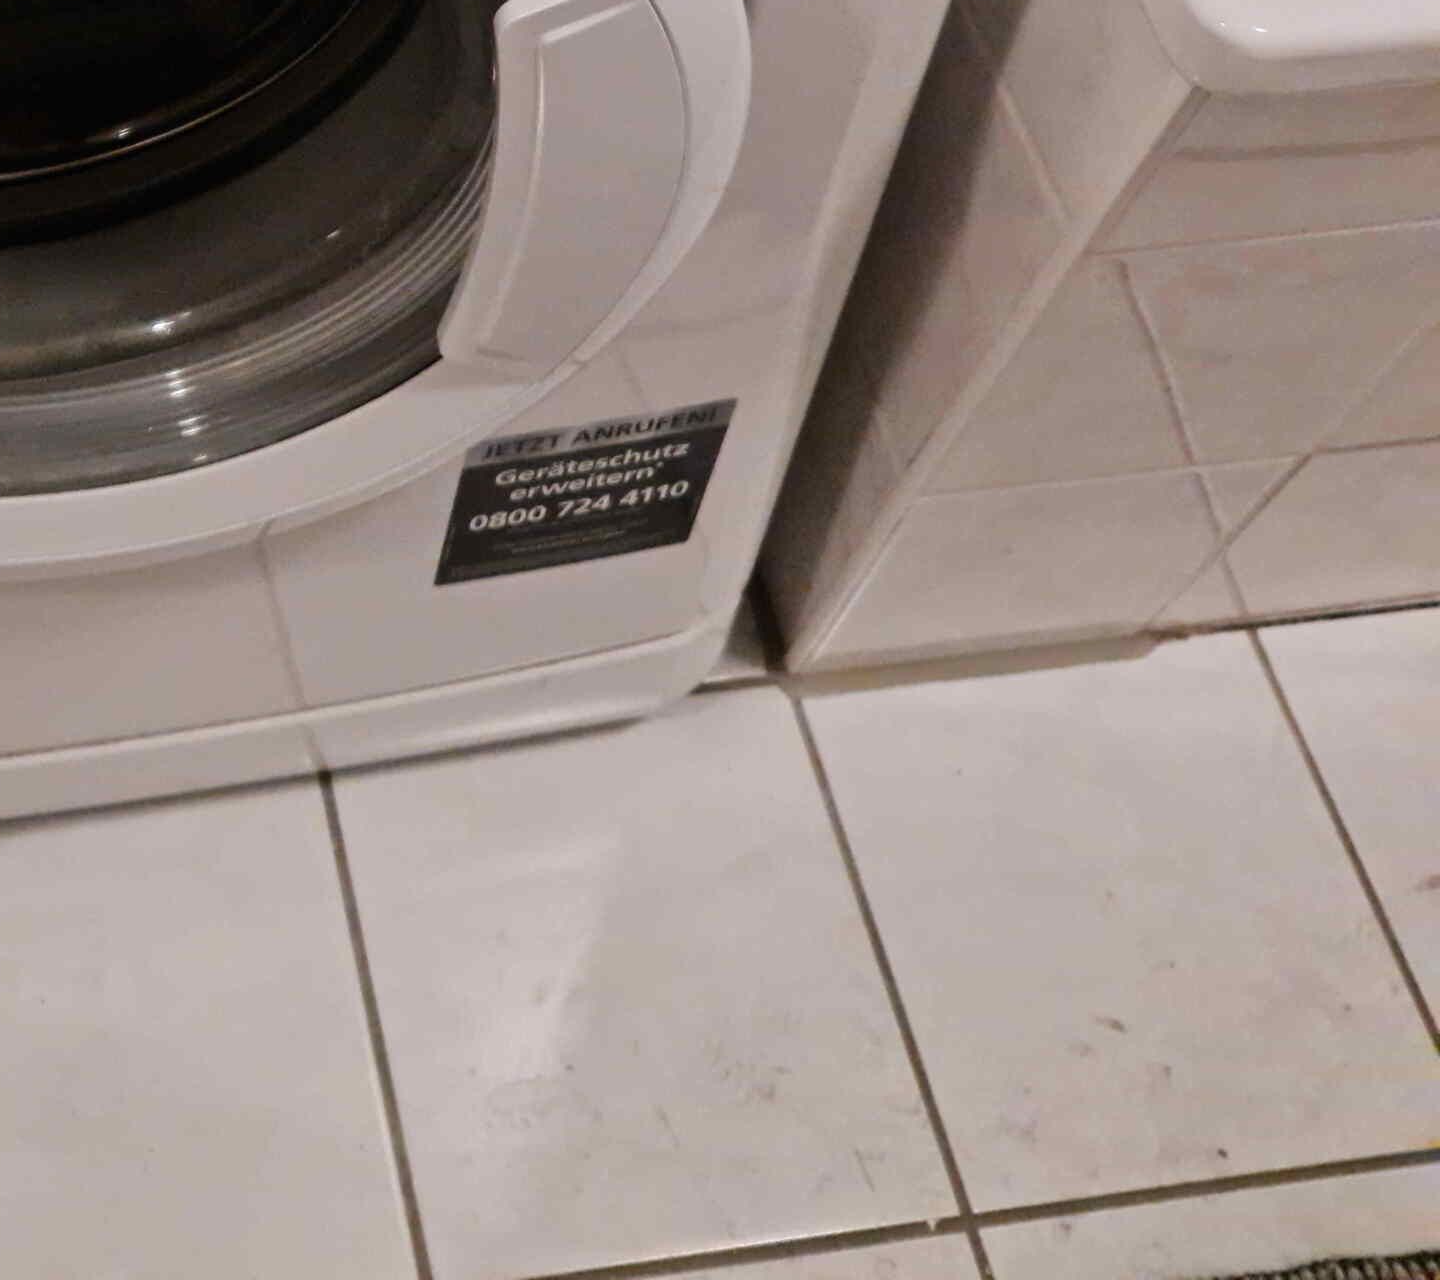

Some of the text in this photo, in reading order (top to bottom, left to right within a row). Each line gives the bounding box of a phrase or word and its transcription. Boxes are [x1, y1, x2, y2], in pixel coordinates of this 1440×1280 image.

[484, 434, 566, 459] JETZT
[495, 441, 691, 486] Geräteschutz
[468, 480, 690, 532] 0800 724 4110
